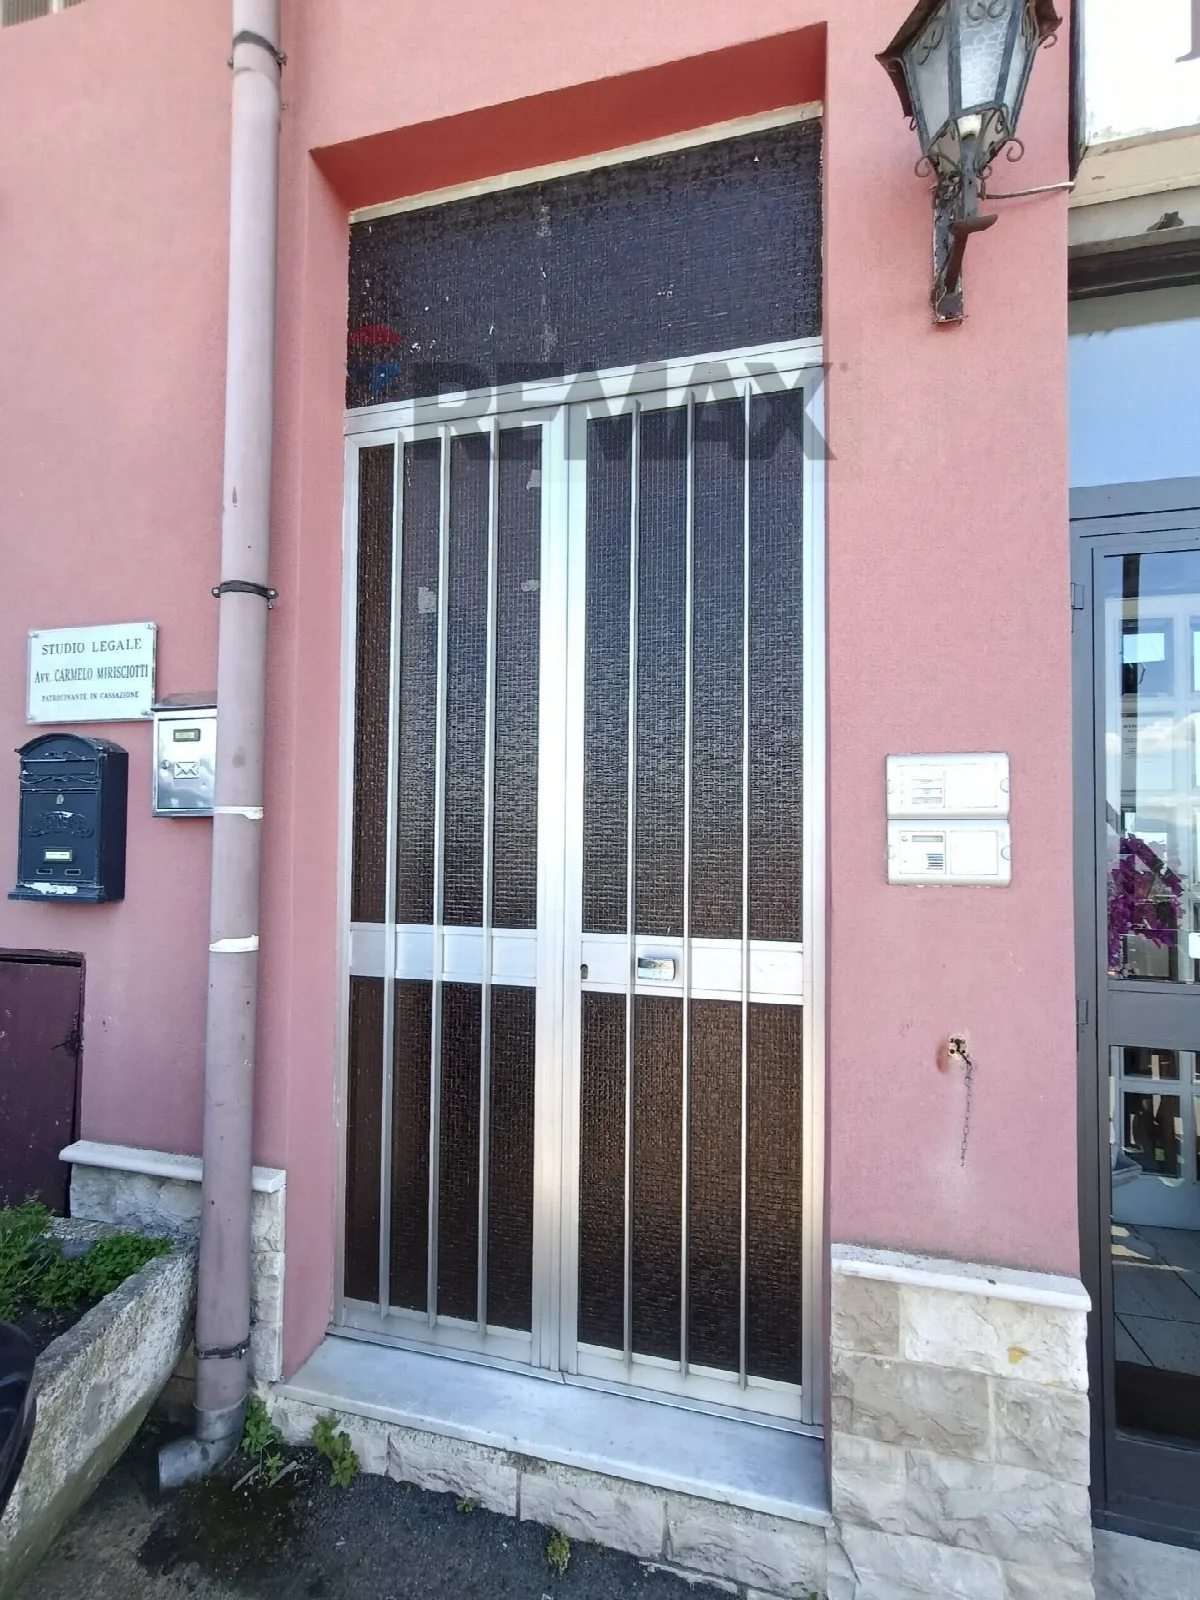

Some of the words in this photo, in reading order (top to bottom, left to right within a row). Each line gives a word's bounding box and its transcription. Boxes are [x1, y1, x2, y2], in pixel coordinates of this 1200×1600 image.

[41, 642, 86, 656] STUDIO
[92, 638, 142, 653] LEGALE
[54, 667, 93, 682] CARMELO
[96, 664, 149, 680] MIRISCIOTTI
[41, 692, 87, 702] PATROCINANTE
[90, 692, 98, 700] IN
[100, 690, 140, 700] CASSAZIONE
